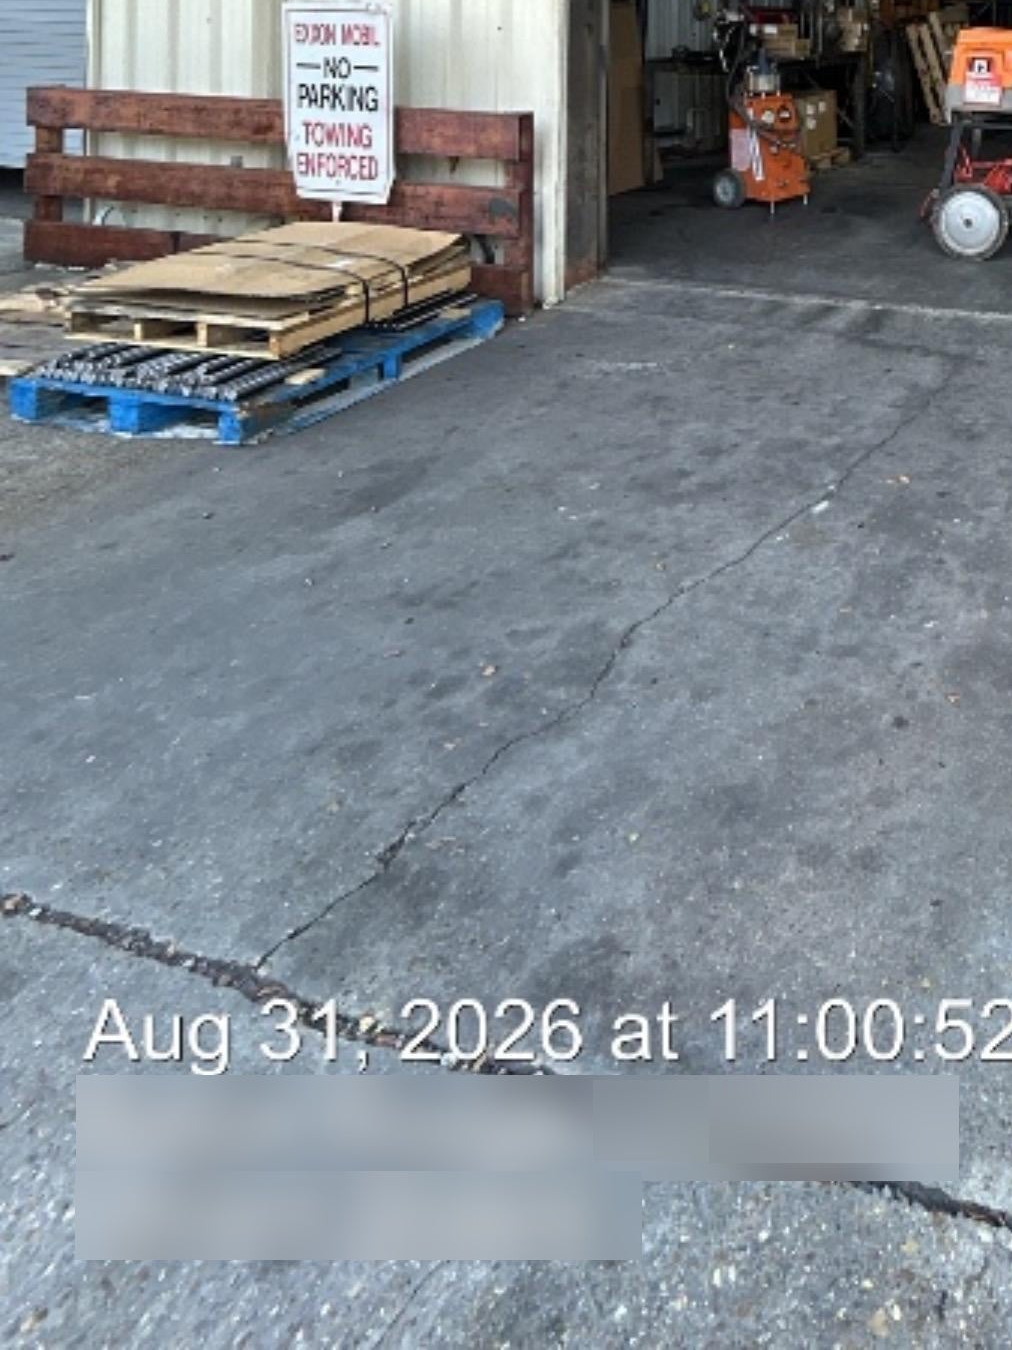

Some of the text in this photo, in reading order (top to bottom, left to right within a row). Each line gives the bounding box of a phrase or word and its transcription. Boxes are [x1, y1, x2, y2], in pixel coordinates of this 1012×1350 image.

[323, 56, 351, 80] NO
[296, 83, 379, 112] PARKING
[302, 122, 372, 149] TOWING
[296, 152, 379, 181] ENFORCED
